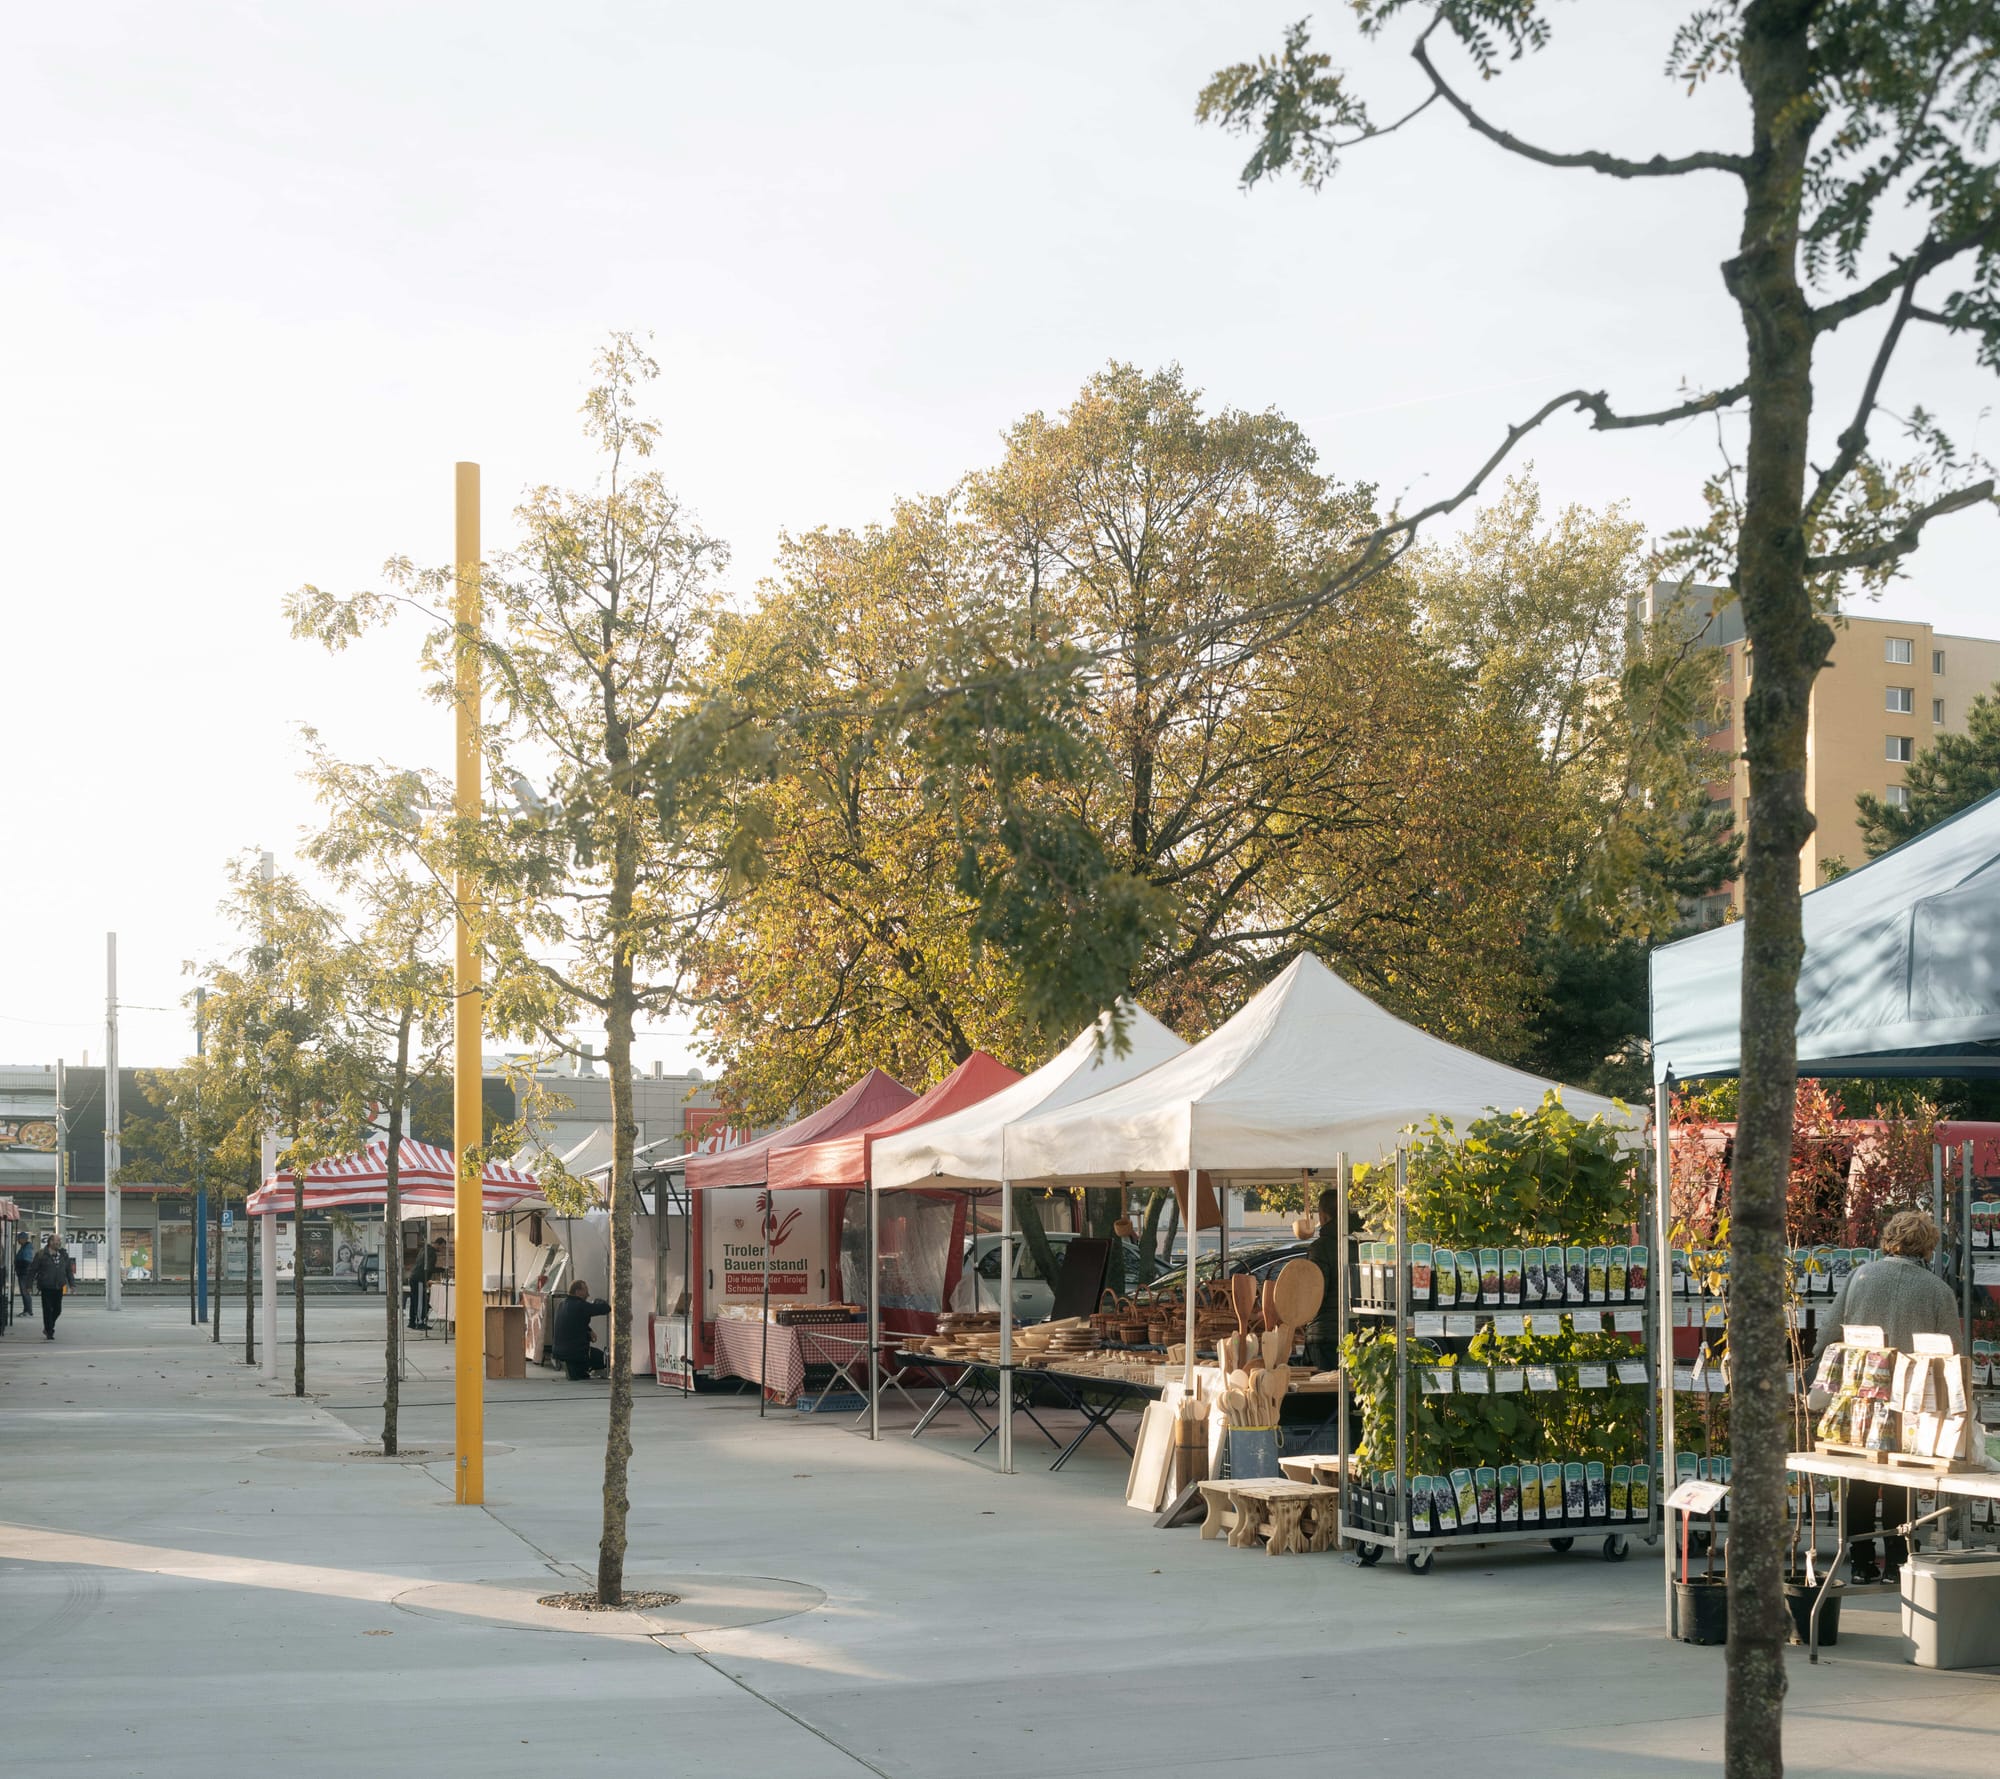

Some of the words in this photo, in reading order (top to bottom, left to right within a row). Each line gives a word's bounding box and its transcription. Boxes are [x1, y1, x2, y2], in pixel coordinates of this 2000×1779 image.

[41, 1230, 106, 1244] aaBox
[723, 1244, 765, 1257] Tiroler
[727, 1275, 740, 1283] Die
[742, 1275, 767, 1283] Heima
[769, 1275, 781, 1283] der
[783, 1275, 806, 1284] Tiroler
